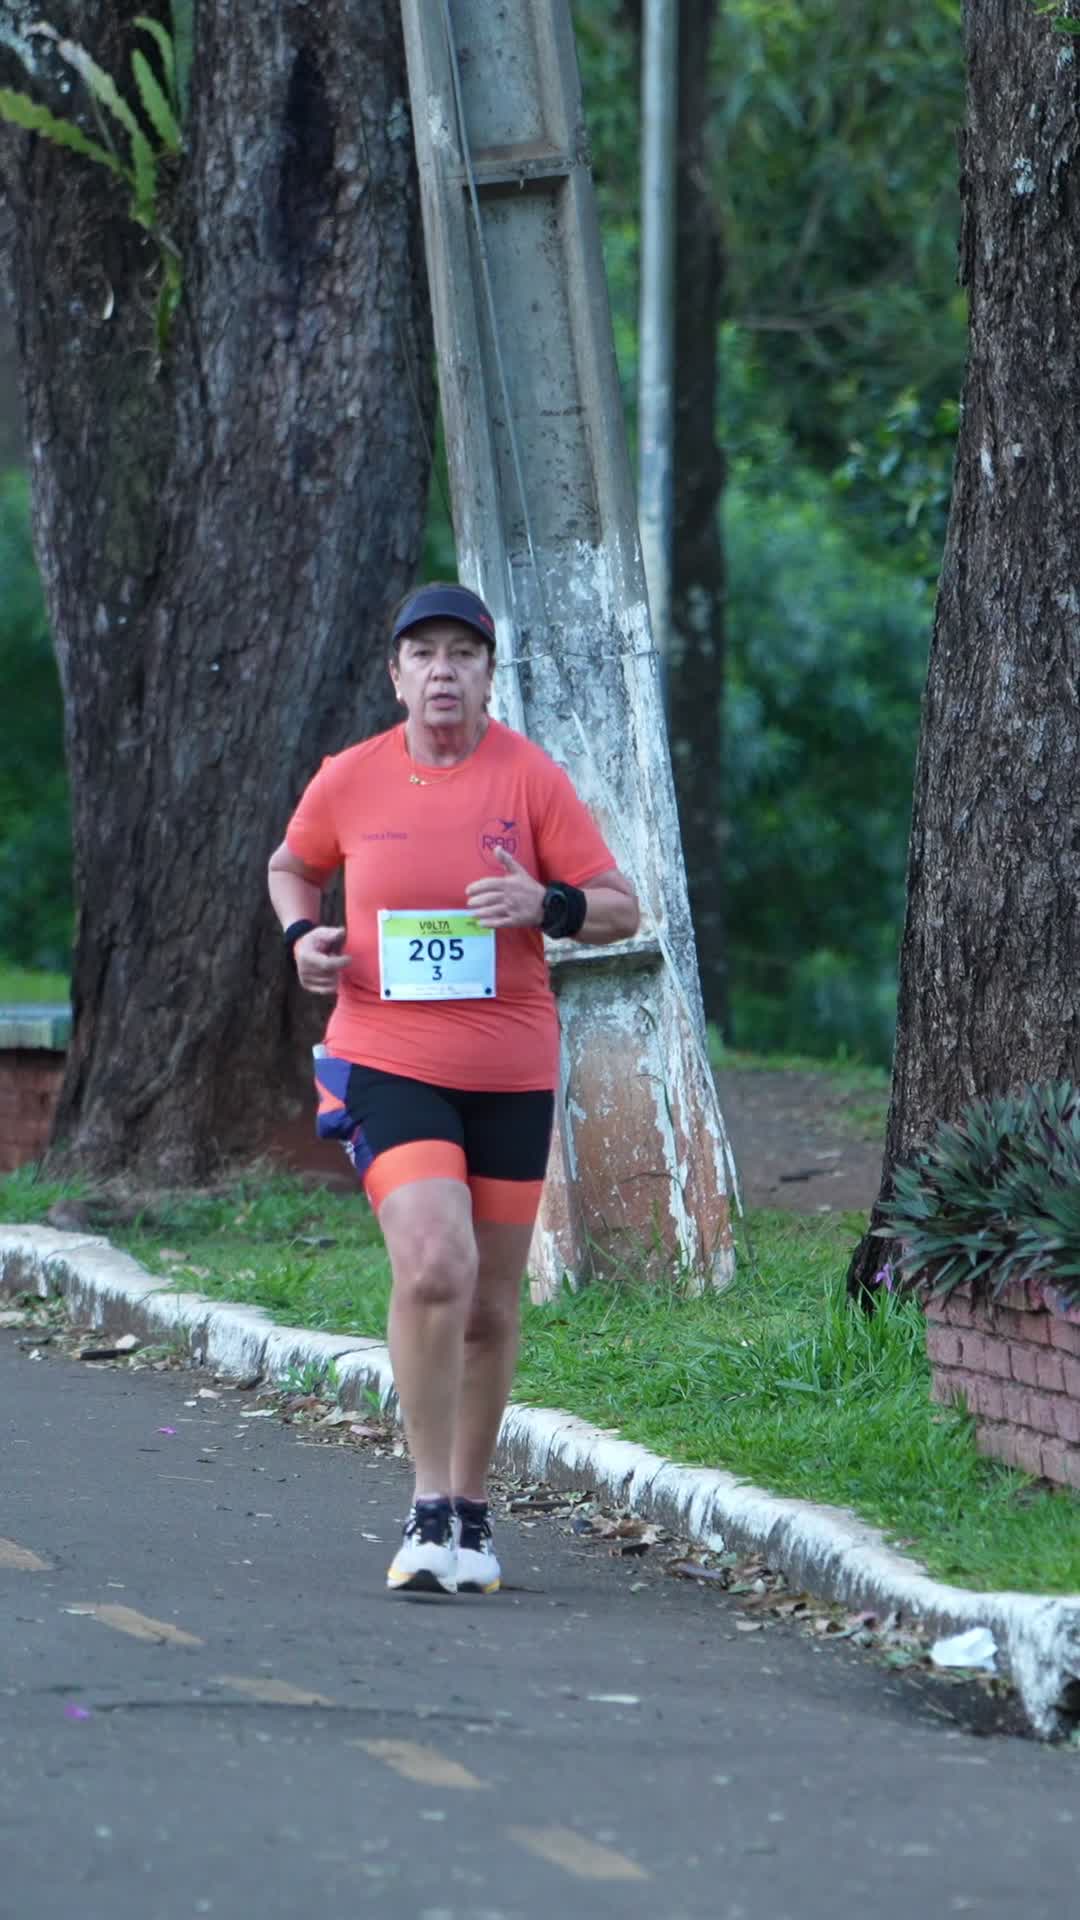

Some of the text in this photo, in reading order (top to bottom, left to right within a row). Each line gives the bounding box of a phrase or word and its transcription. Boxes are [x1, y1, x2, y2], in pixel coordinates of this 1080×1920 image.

[419, 920, 450, 930] VOLTA
[408, 938, 464, 962] 205
[432, 965, 443, 981] 3
